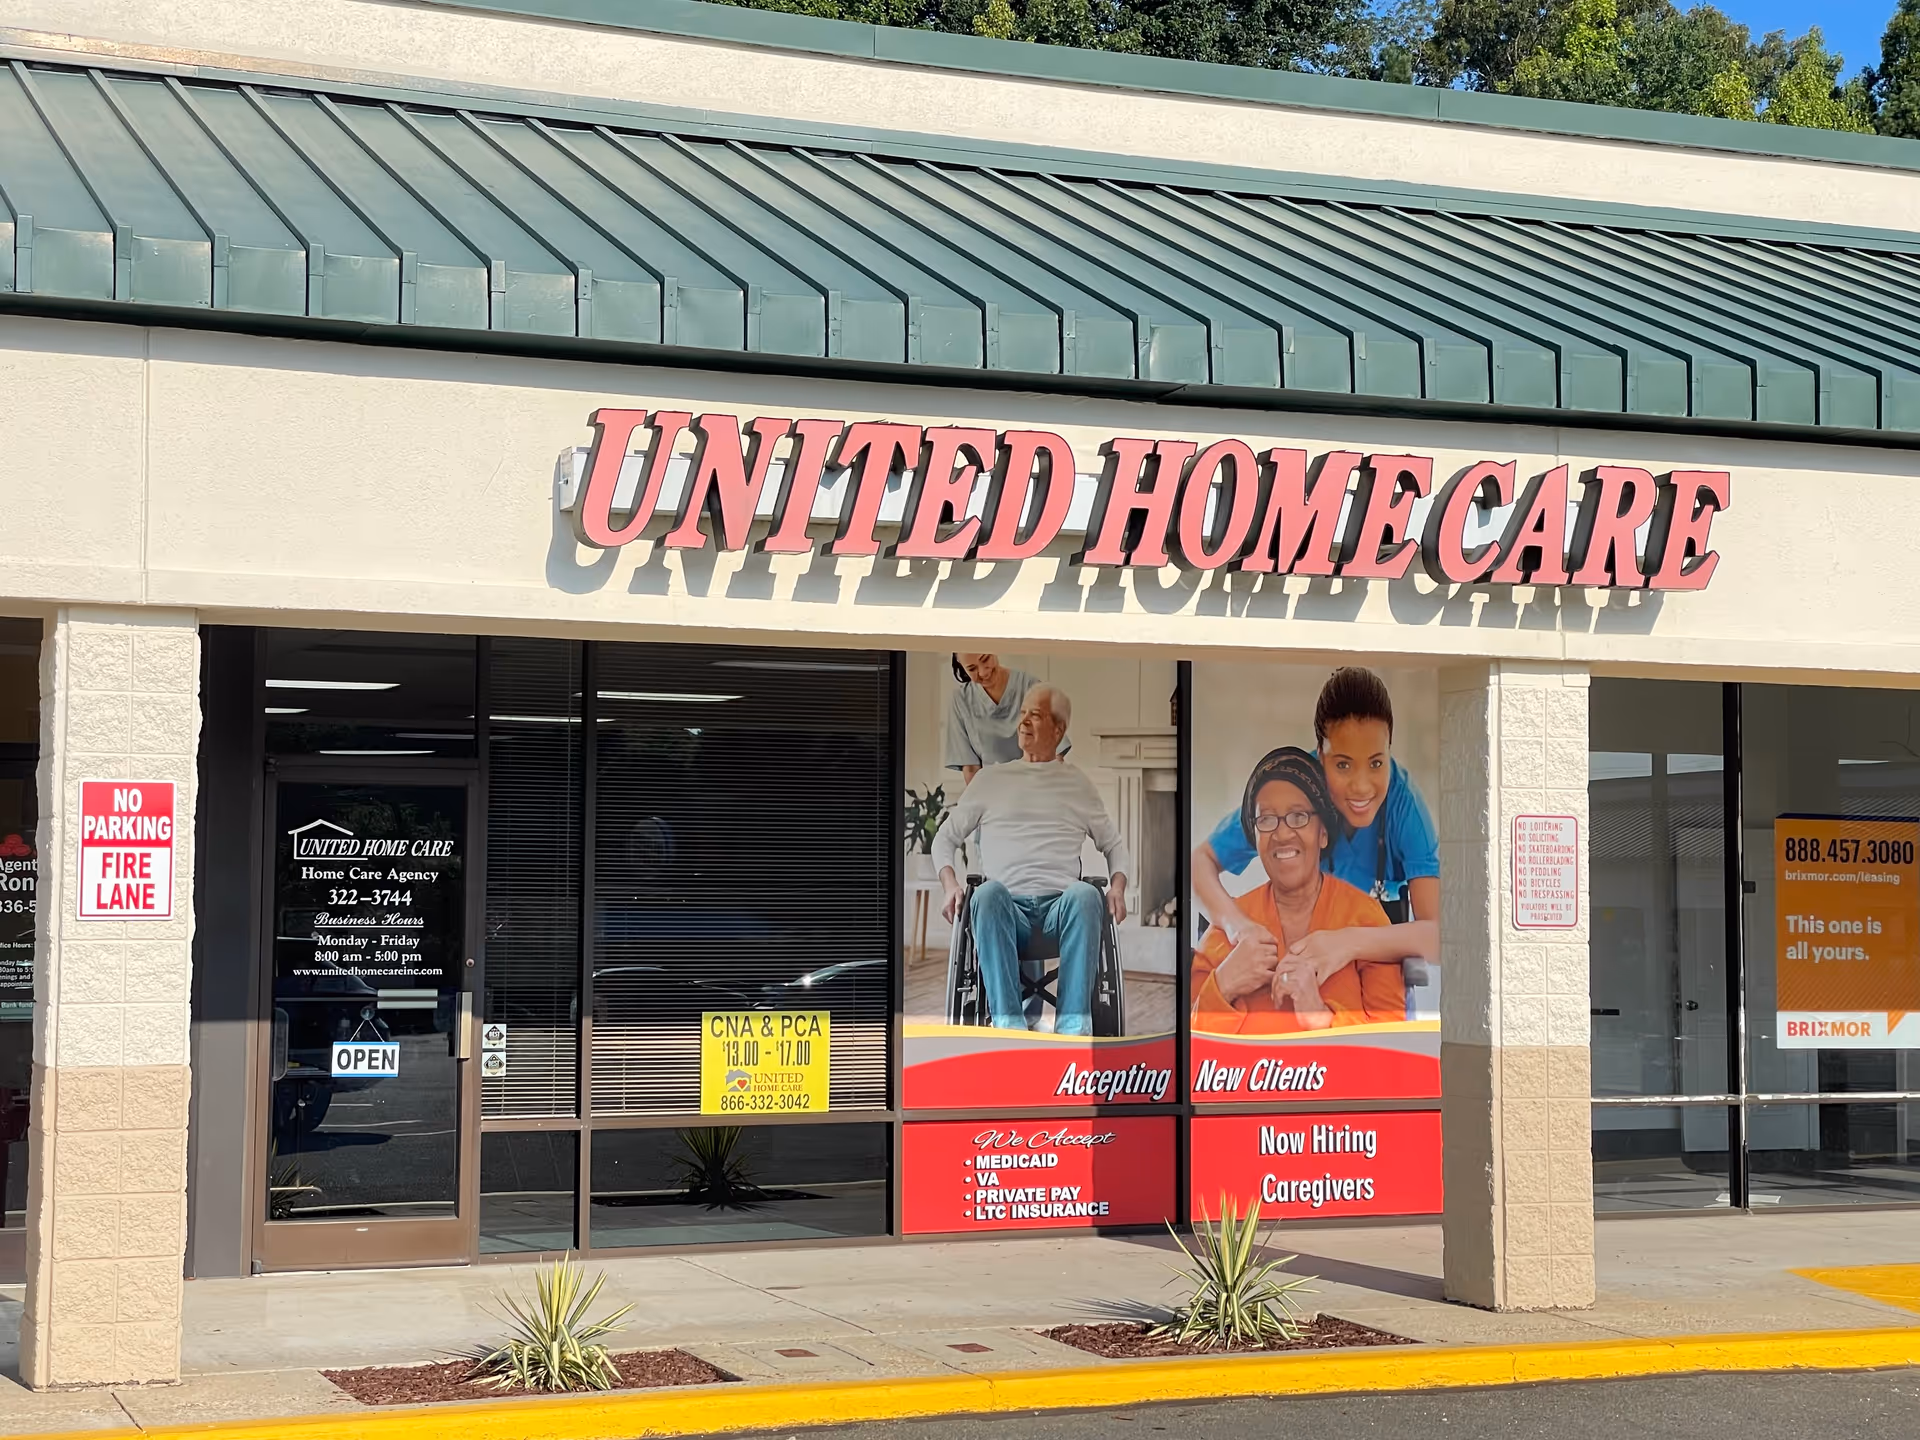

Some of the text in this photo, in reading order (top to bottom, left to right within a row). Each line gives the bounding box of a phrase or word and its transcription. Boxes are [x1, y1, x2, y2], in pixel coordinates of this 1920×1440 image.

[578, 408, 1731, 591] UNITED HOME CARE
[114, 788, 142, 812] NO
[84, 815, 171, 840] PARKING
[1518, 822, 1563, 831] NO LOITERING
[1519, 833, 1559, 843] NO SOLICITING
[299, 838, 454, 857] UNITED HOME CARE
[1519, 845, 1575, 854] NO SKATEBOARDING
[1785, 837, 1914, 865] 888.457.3080
[102, 852, 152, 878] FIRE
[1519, 856, 1574, 865] NO ROLLERBLADING
[301, 867, 439, 883] Home Care Agency
[1519, 867, 1561, 877] NO PEDDLING
[1785, 869, 1900, 885] brixmor.com/leasing
[1519, 879, 1561, 888] NO BICYCLES
[96, 883, 155, 909] LANE
[1519, 890, 1574, 899] NO TRESPASSING
[314, 912, 424, 926] Business Hours
[1786, 915, 1882, 934] This one is
[317, 934, 368, 949] Monday
[380, 934, 420, 949] Friday
[314, 951, 339, 962] 8:00
[342, 953, 362, 962] am
[374, 950, 398, 962] 5:00
[401, 953, 422, 964] pm
[1786, 941, 1870, 963] all yours.
[293, 966, 443, 976] www.unitedhomecareinc.com
[711, 1015, 822, 1038] CNA & PCA
[1787, 1021, 1871, 1037] BRIXMOR
[337, 1048, 396, 1070] OPEN
[722, 1040, 759, 1067] $13.00
[776, 1040, 810, 1066] $17.00
[754, 1072, 804, 1084] UNITED
[1055, 1058, 1327, 1101] Accepting New Clients
[781, 1084, 803, 1092] CARE
[721, 1094, 810, 1111] 866-332-3042
[973, 1128, 1116, 1149] We Accept
[1260, 1124, 1377, 1159] Now Hiring
[975, 1153, 1058, 1170] MEDICAID
[976, 1172, 1000, 1187] VA
[975, 1186, 1081, 1204] PRIVATE PAY
[1262, 1172, 1374, 1209] Caregivers
[975, 1201, 1110, 1221] LTC INSURANCE
